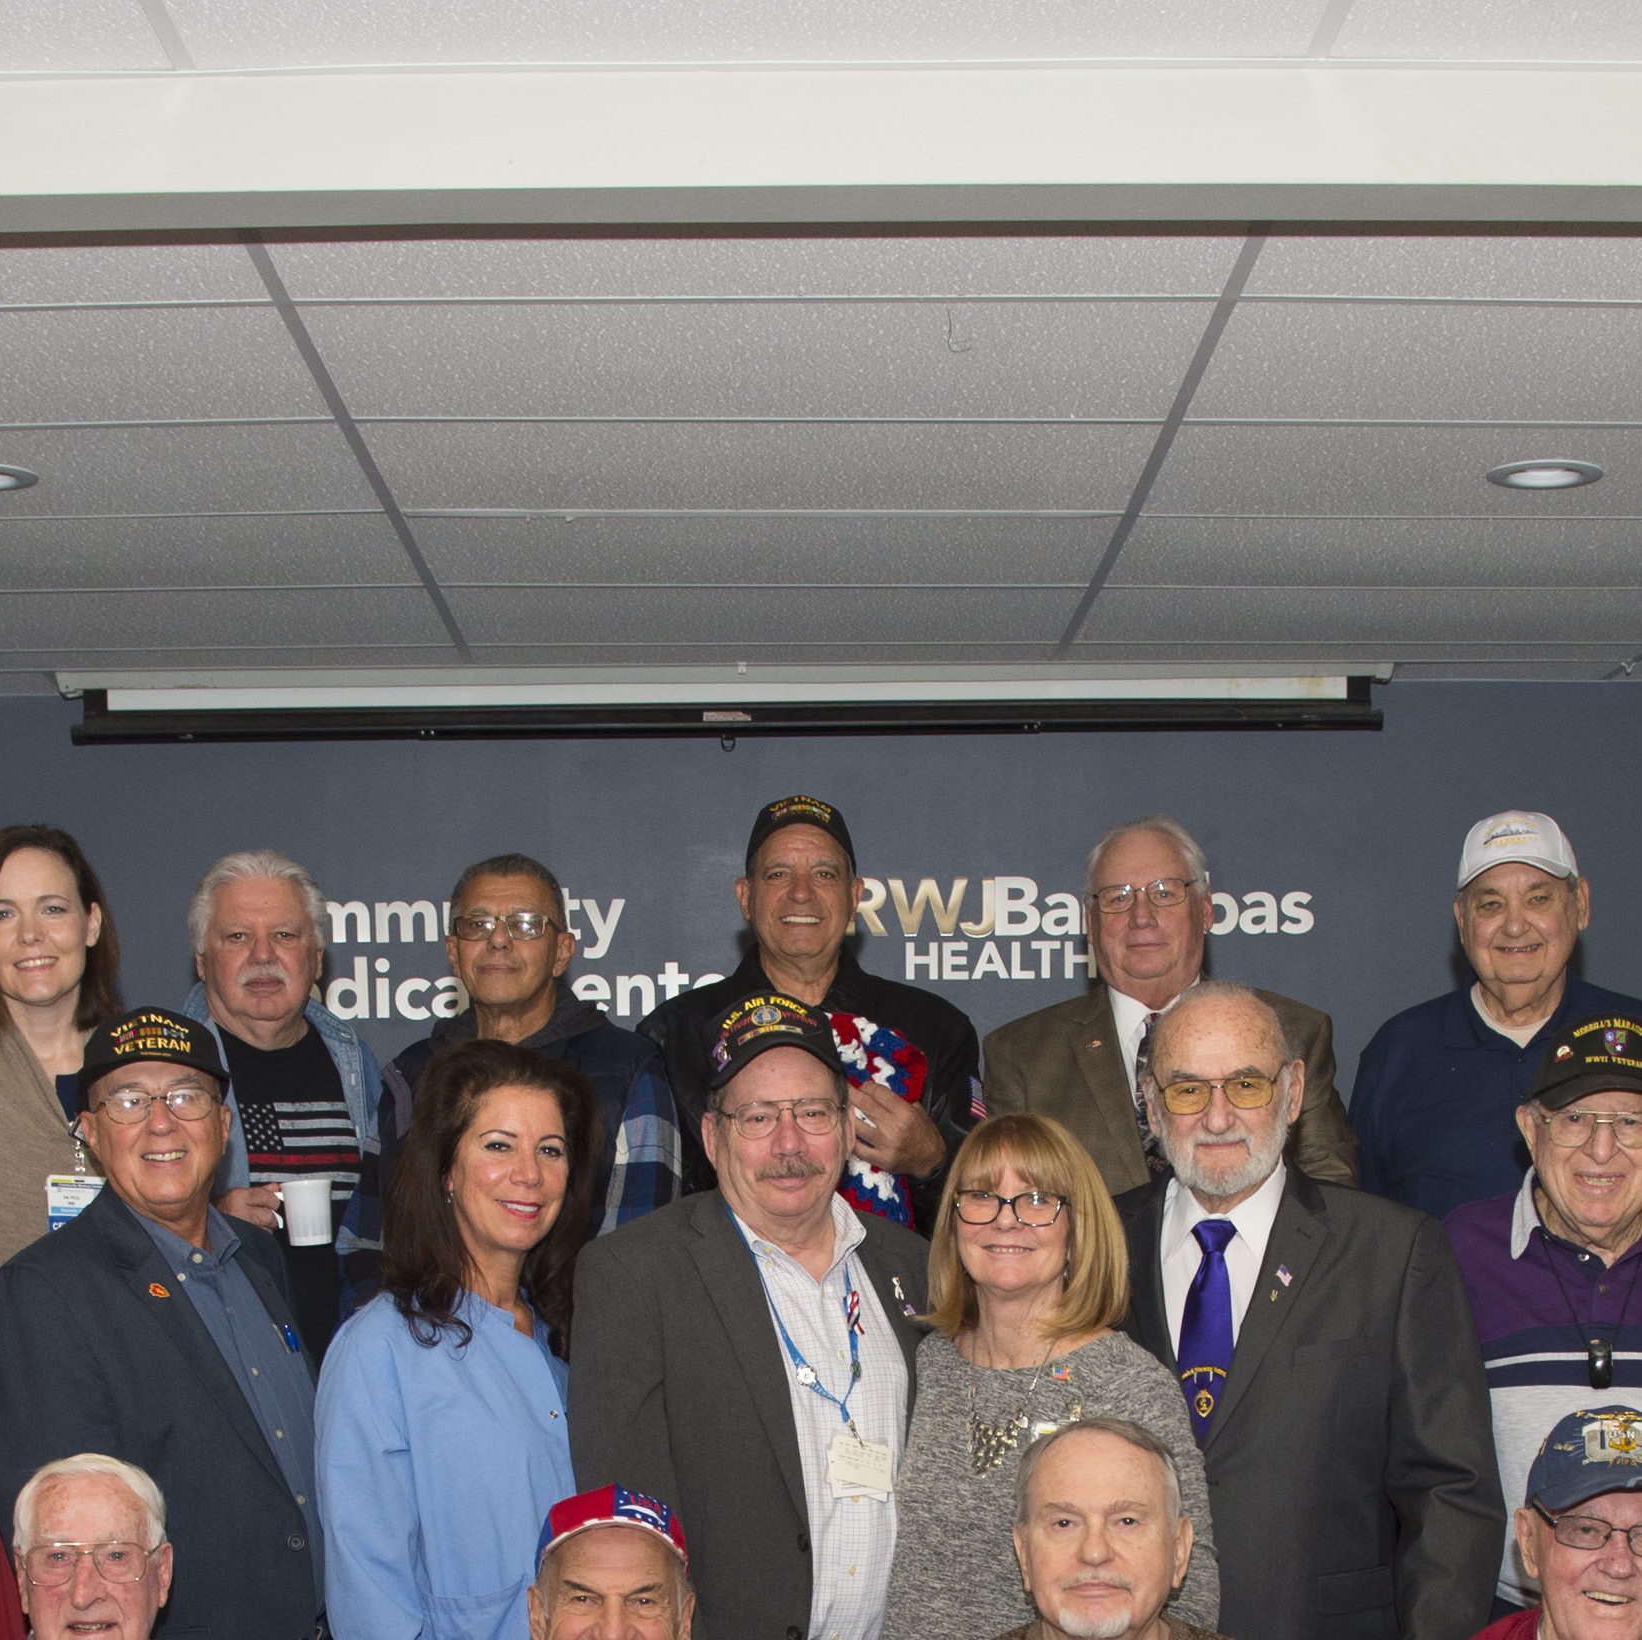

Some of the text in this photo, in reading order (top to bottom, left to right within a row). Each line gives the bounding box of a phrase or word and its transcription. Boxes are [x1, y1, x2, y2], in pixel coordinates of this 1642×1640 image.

[905, 940, 1098, 982] HEALTH
[110, 1013, 190, 1037] VIETNAM
[722, 996, 808, 1030] U.S. AIR FORCE
[113, 1037, 192, 1055] VETERAN
[1608, 1429, 1636, 1440] USN
[628, 1493, 662, 1517] USA
